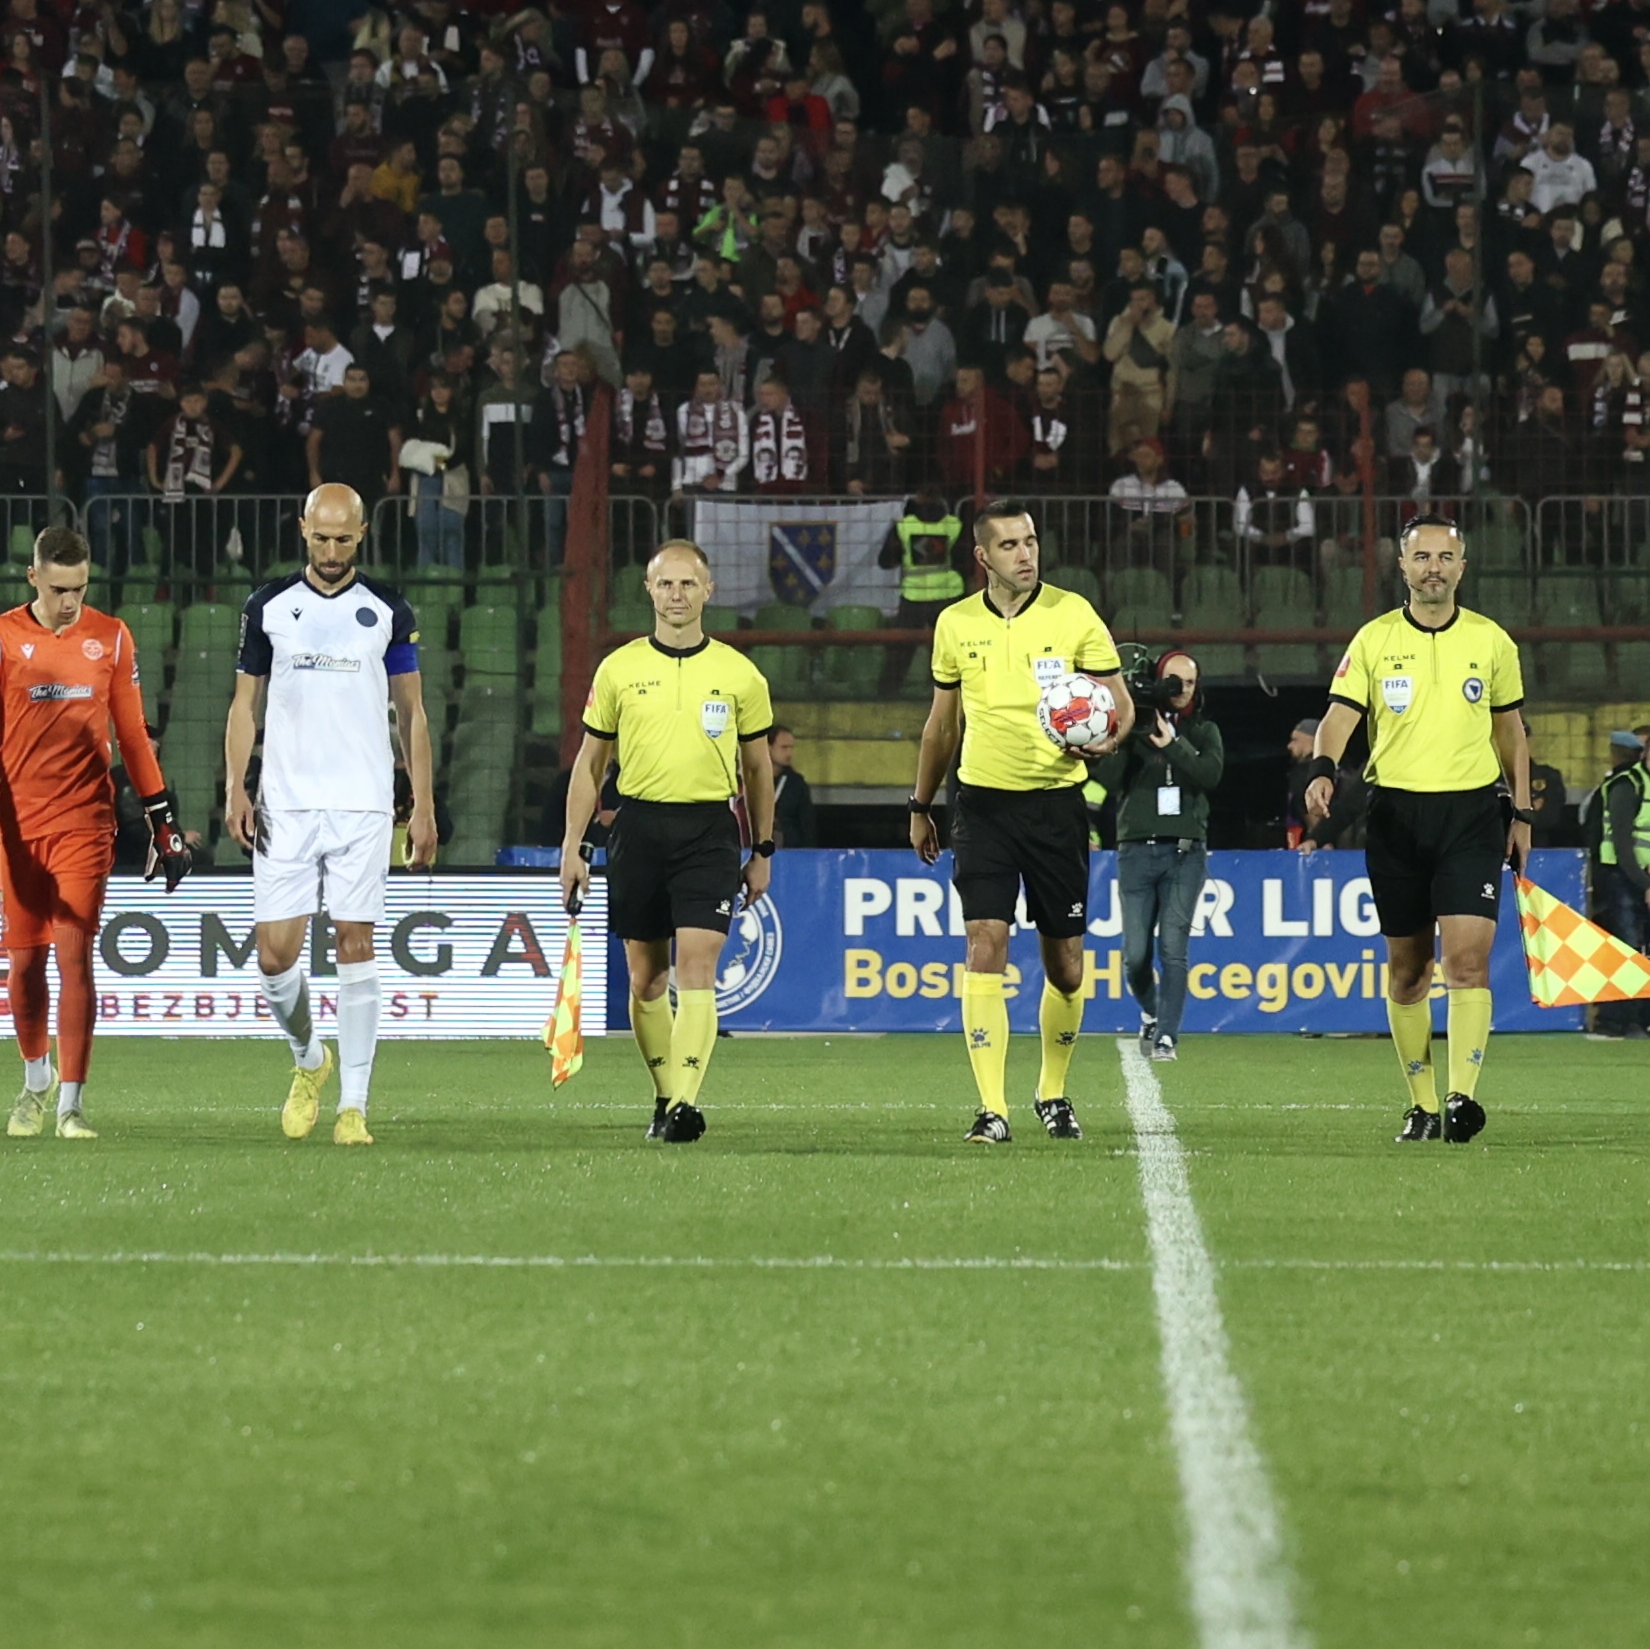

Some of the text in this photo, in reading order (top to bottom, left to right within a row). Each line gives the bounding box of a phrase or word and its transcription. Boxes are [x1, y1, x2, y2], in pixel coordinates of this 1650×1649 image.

[960, 639, 992, 647] KELME
[629, 680, 661, 689] KELME
[1385, 679, 1408, 690] FIFA
[28, 684, 48, 698] The
[705, 703, 726, 713] FIFA
[1039, 708, 1061, 745] SELECT
[1263, 877, 1439, 937] LIG
